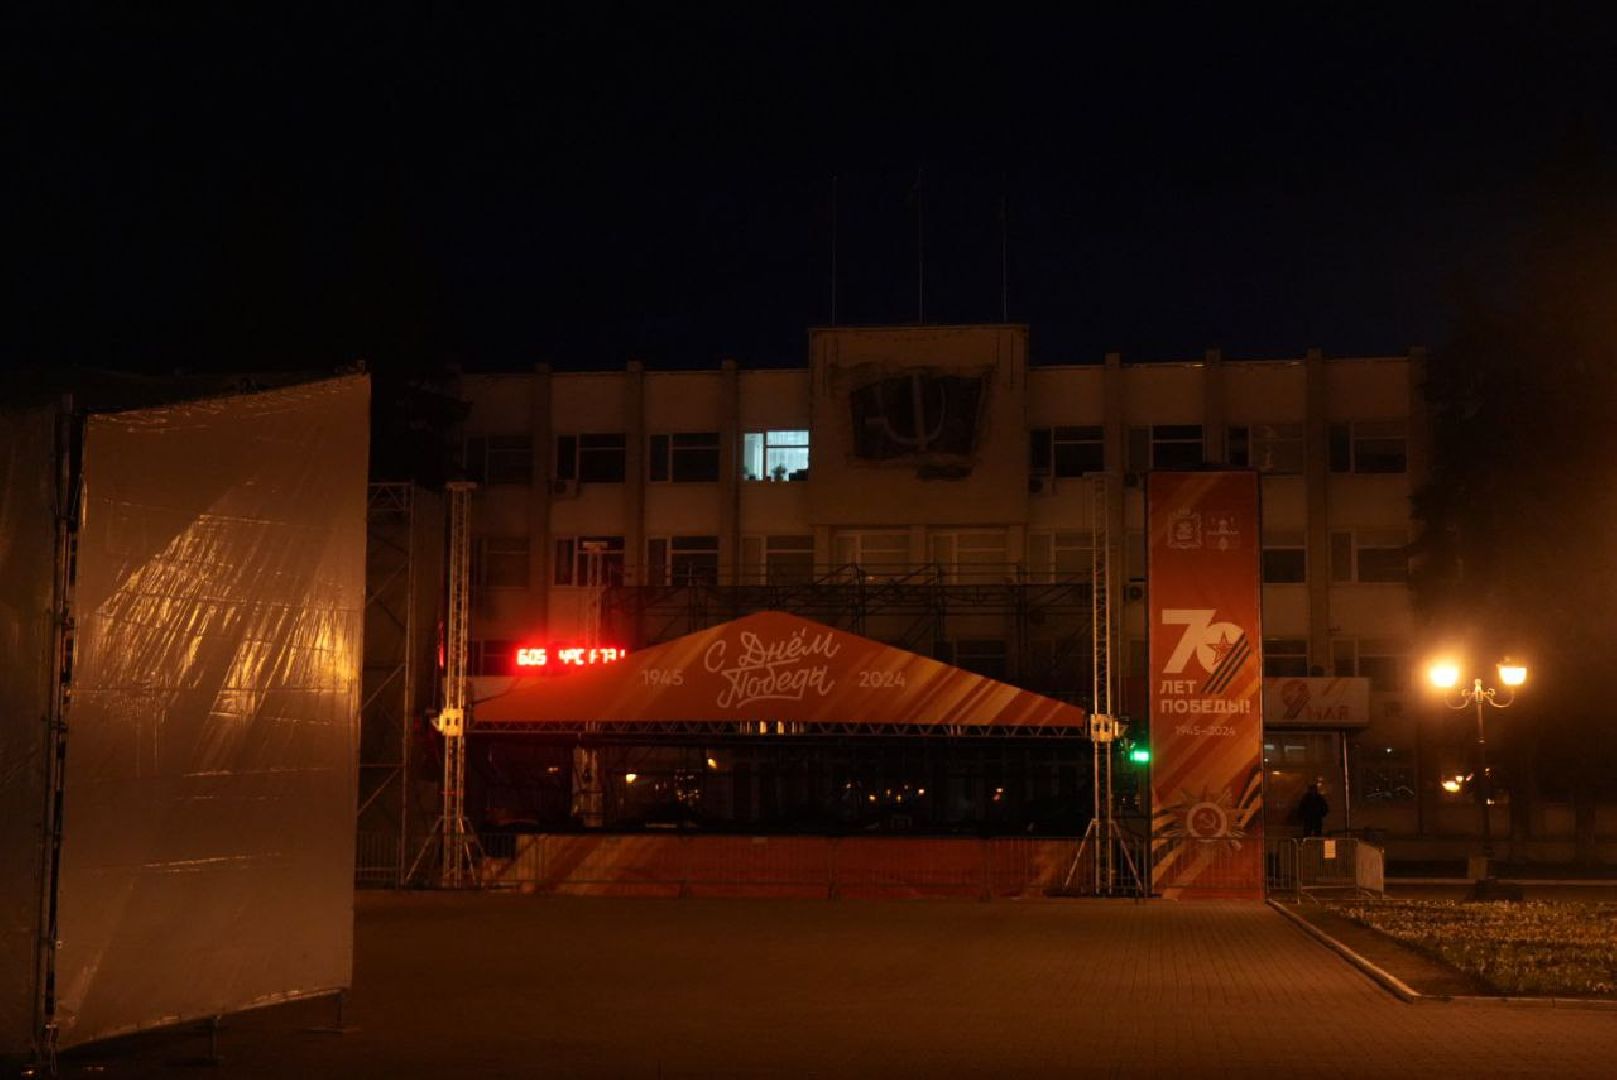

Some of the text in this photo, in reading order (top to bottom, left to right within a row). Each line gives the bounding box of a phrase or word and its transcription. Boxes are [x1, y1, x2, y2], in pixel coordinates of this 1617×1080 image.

[704, 627, 841, 672] С Днём
[643, 670, 684, 686] 1945
[859, 671, 906, 688] 2024
[717, 665, 835, 708] Победы
[1160, 680, 1197, 694] ЛЕТ
[1161, 699, 1250, 713] ПОБЕДЫ!
